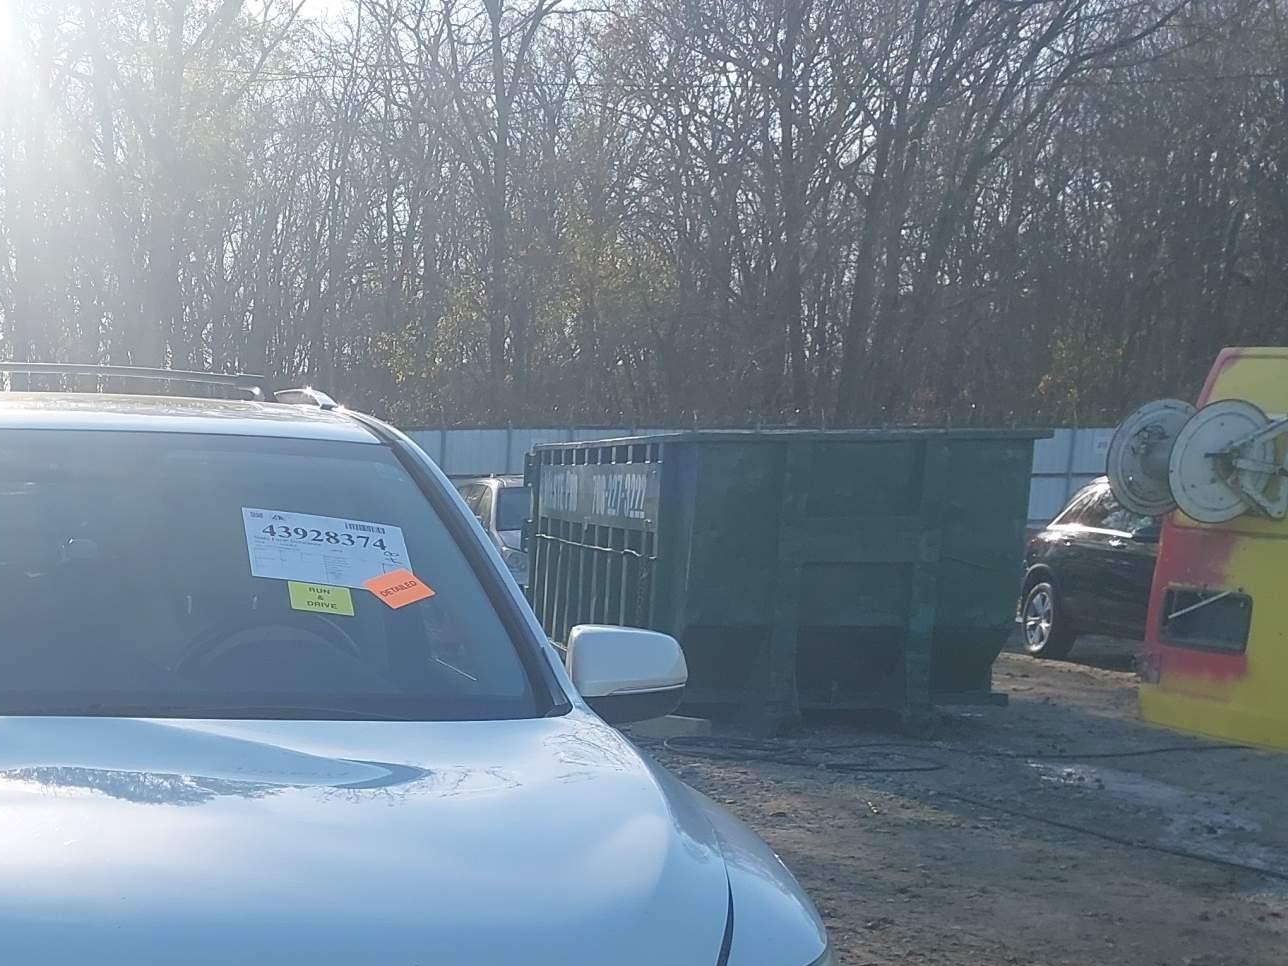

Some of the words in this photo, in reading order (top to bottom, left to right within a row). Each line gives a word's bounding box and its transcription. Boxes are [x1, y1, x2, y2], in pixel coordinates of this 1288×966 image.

[262, 524, 386, 551] 43928374
[308, 587, 330, 595] RUN
[380, 580, 417, 597] DETAILED
[307, 600, 338, 610] DRIVE
